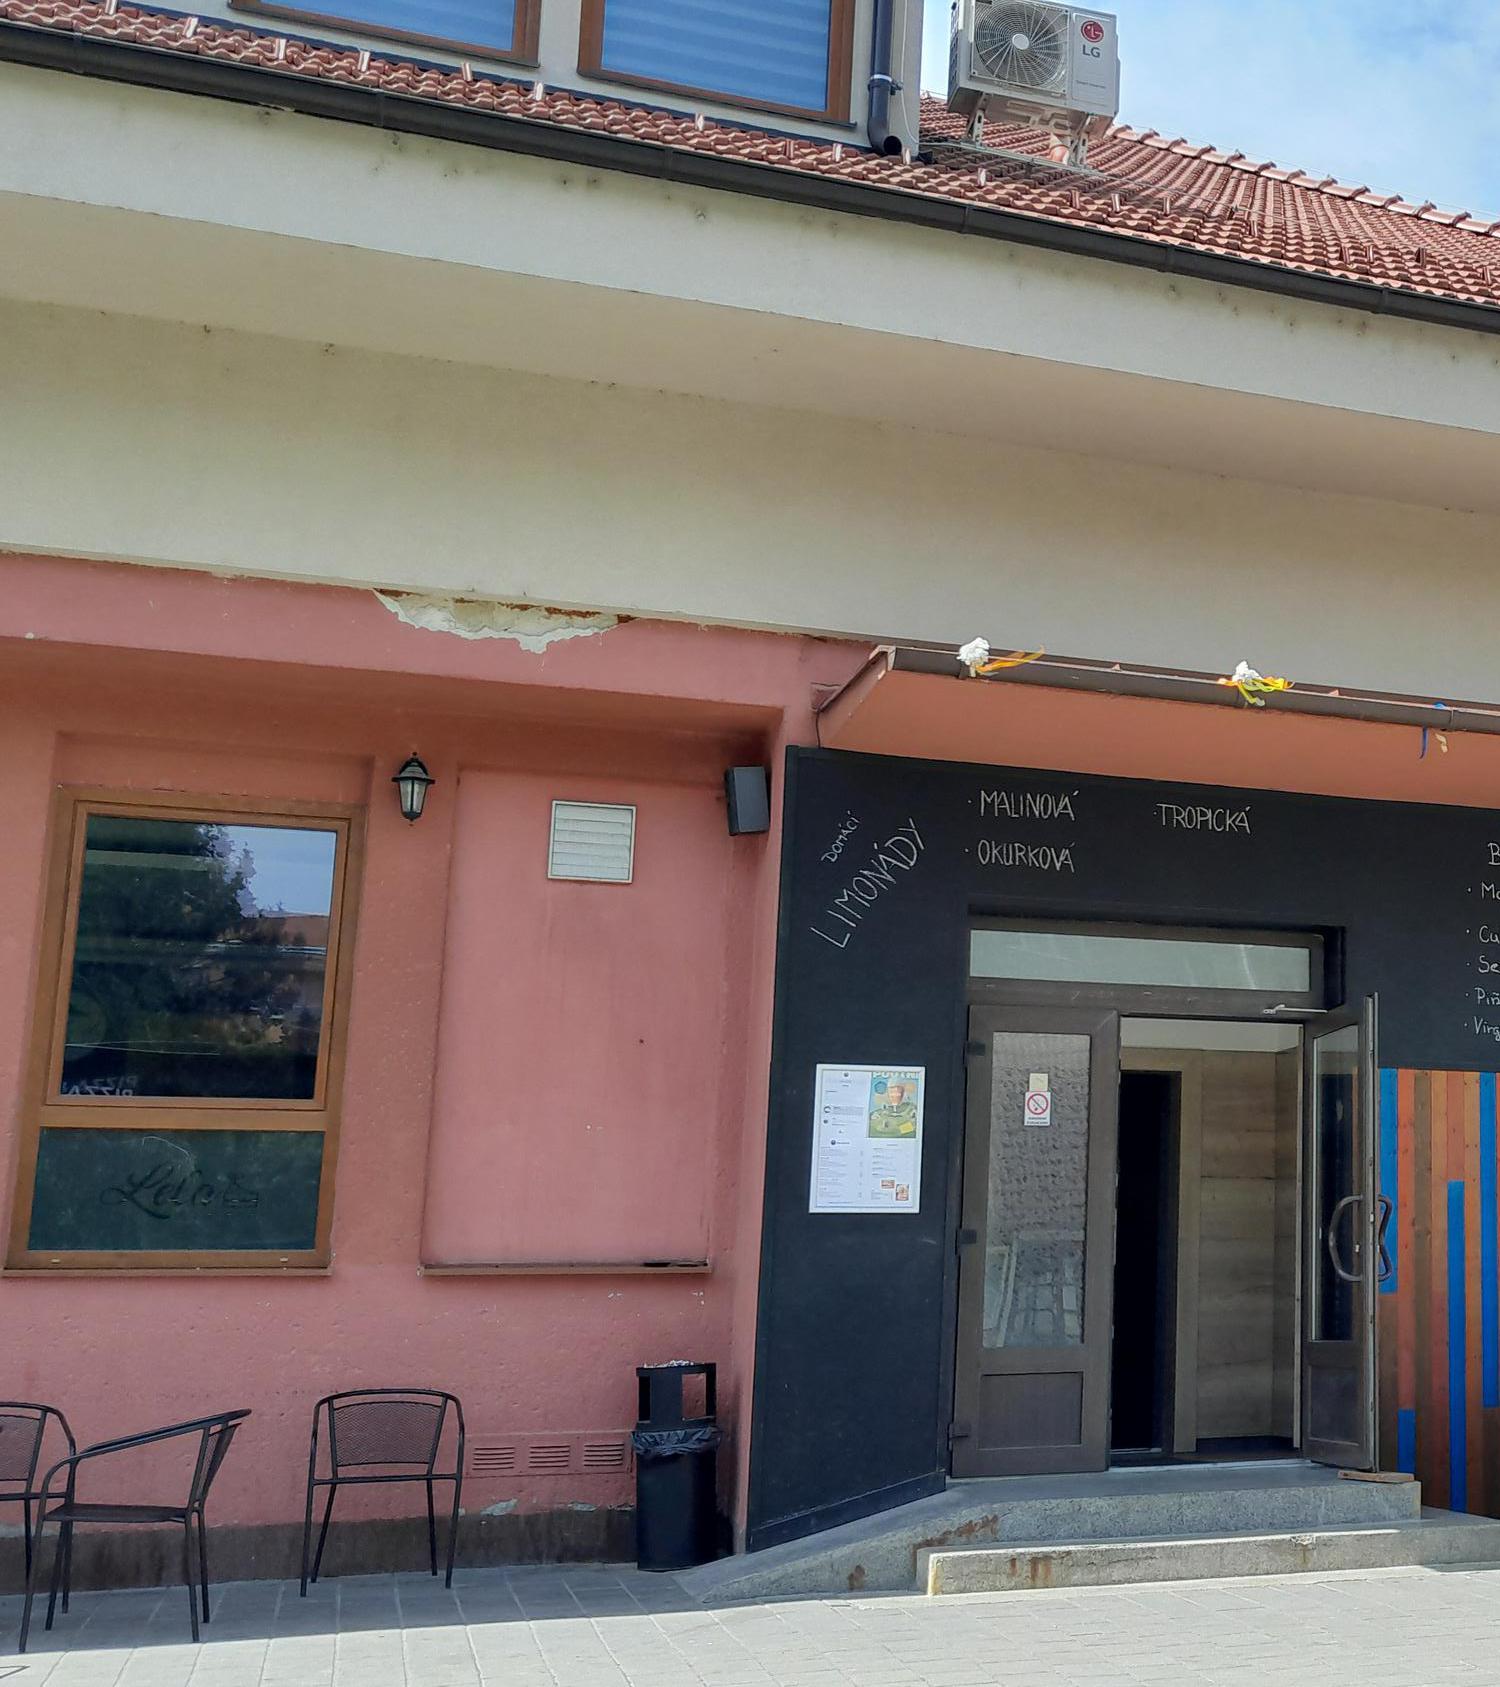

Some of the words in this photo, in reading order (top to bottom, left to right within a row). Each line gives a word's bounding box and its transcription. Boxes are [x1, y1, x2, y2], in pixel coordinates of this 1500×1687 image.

[1082, 44, 1101, 58] LG
[979, 790, 1080, 821] MALINOVÁ
[1155, 803, 1251, 835] TROPICKÁ
[977, 840, 1075, 873] OKURKOVÁ
[810, 817, 925, 949] LIMONÁDY
